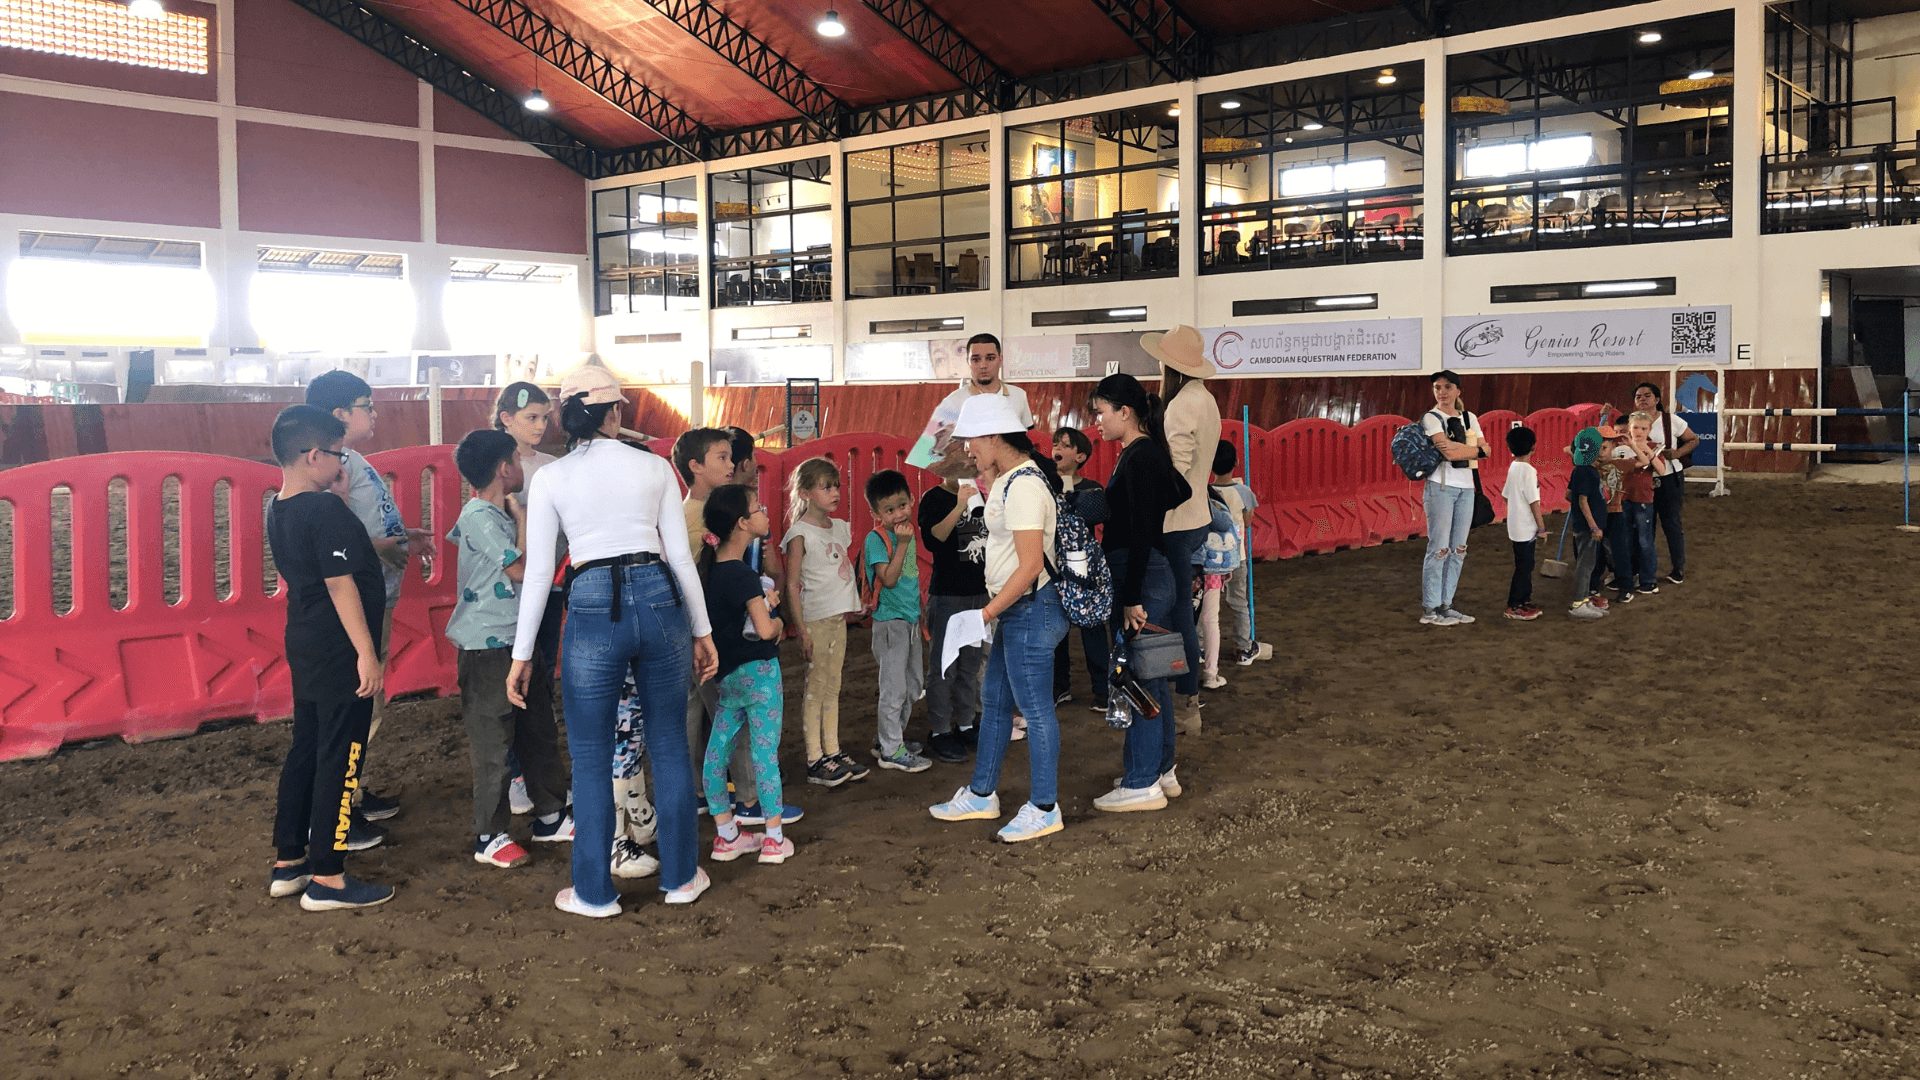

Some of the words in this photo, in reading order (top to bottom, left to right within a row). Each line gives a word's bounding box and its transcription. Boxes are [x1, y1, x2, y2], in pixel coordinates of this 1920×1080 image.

[1524, 325, 1581, 357] Genius
[1588, 323, 1645, 349] Resort
[1250, 356, 1296, 365] CAMBODIAN
[1297, 354, 1345, 364] EQUESTRIAN
[1347, 353, 1397, 362] FEDERATION
[1548, 351, 1584, 359] Empowering
[1737, 344, 1751, 360] E
[1108, 362, 1117, 373] V
[333, 742, 362, 851] BATMAN
